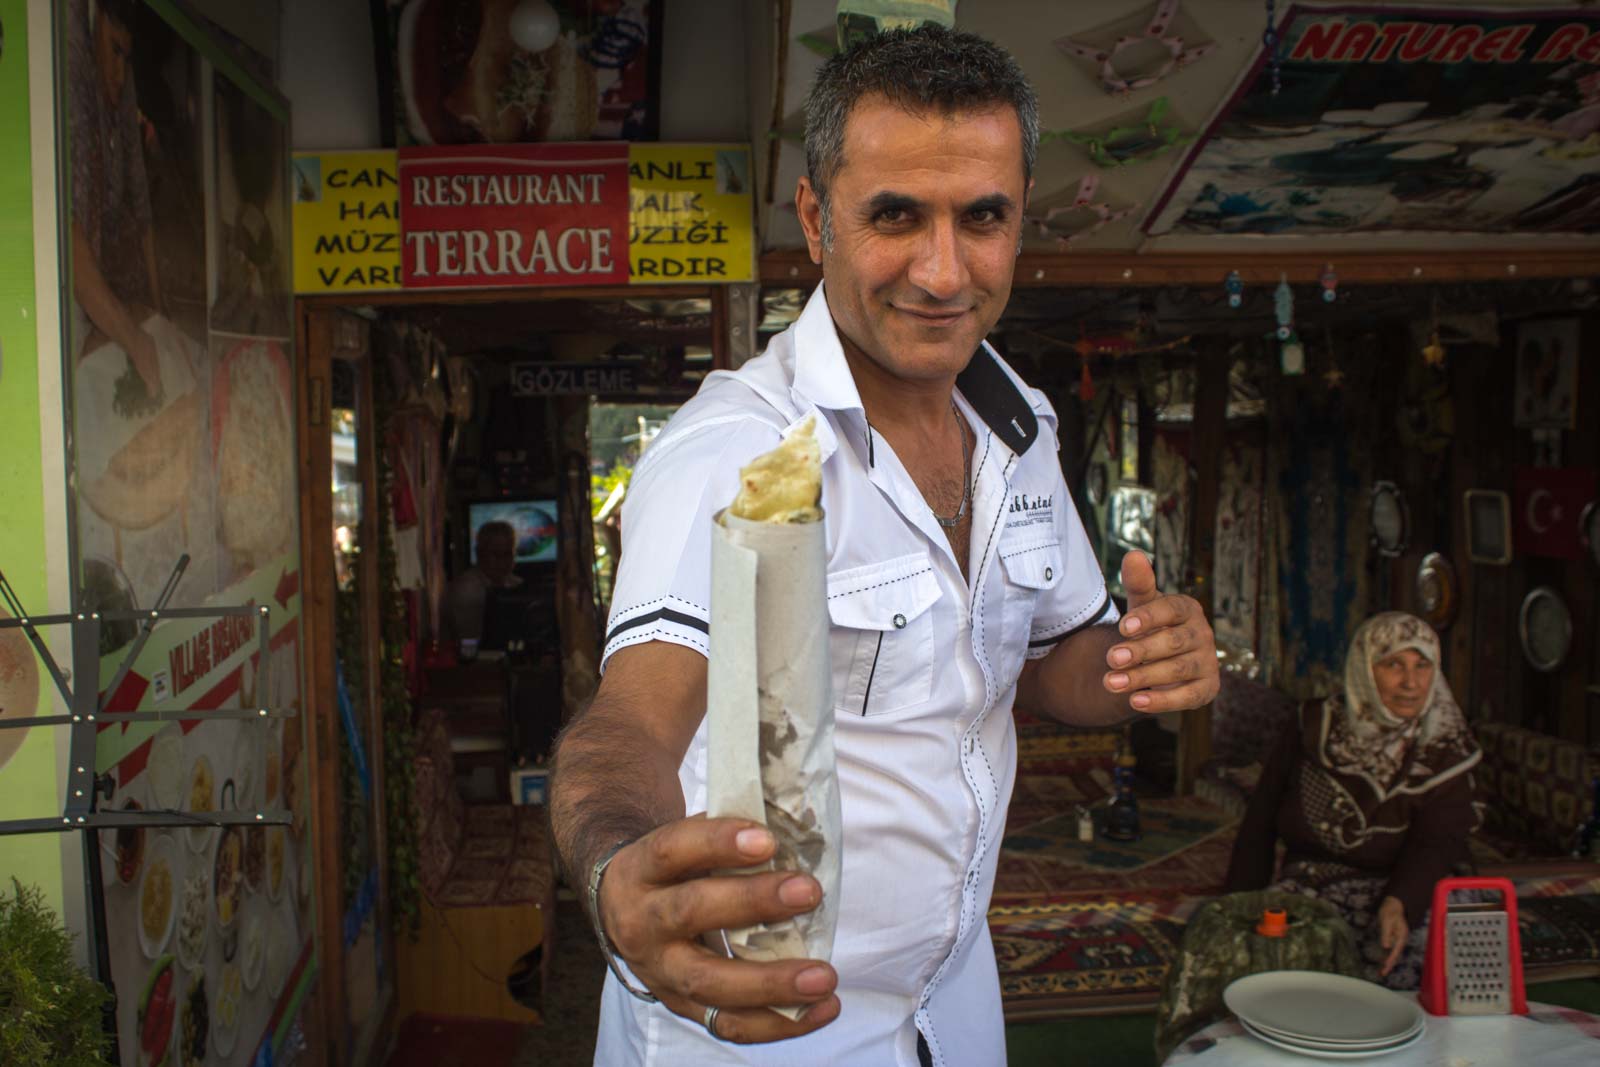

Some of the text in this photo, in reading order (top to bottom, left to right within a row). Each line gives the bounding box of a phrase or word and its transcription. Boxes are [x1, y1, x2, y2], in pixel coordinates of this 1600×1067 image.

[1289, 22, 1536, 63] NATUREL
[412, 173, 606, 206] RESTAURANT
[630, 192, 704, 212] ALK
[315, 229, 401, 254] MÜZ
[405, 227, 614, 278] TERRACE
[629, 257, 728, 277] RDIR
[168, 627, 211, 698] VILLAGE
